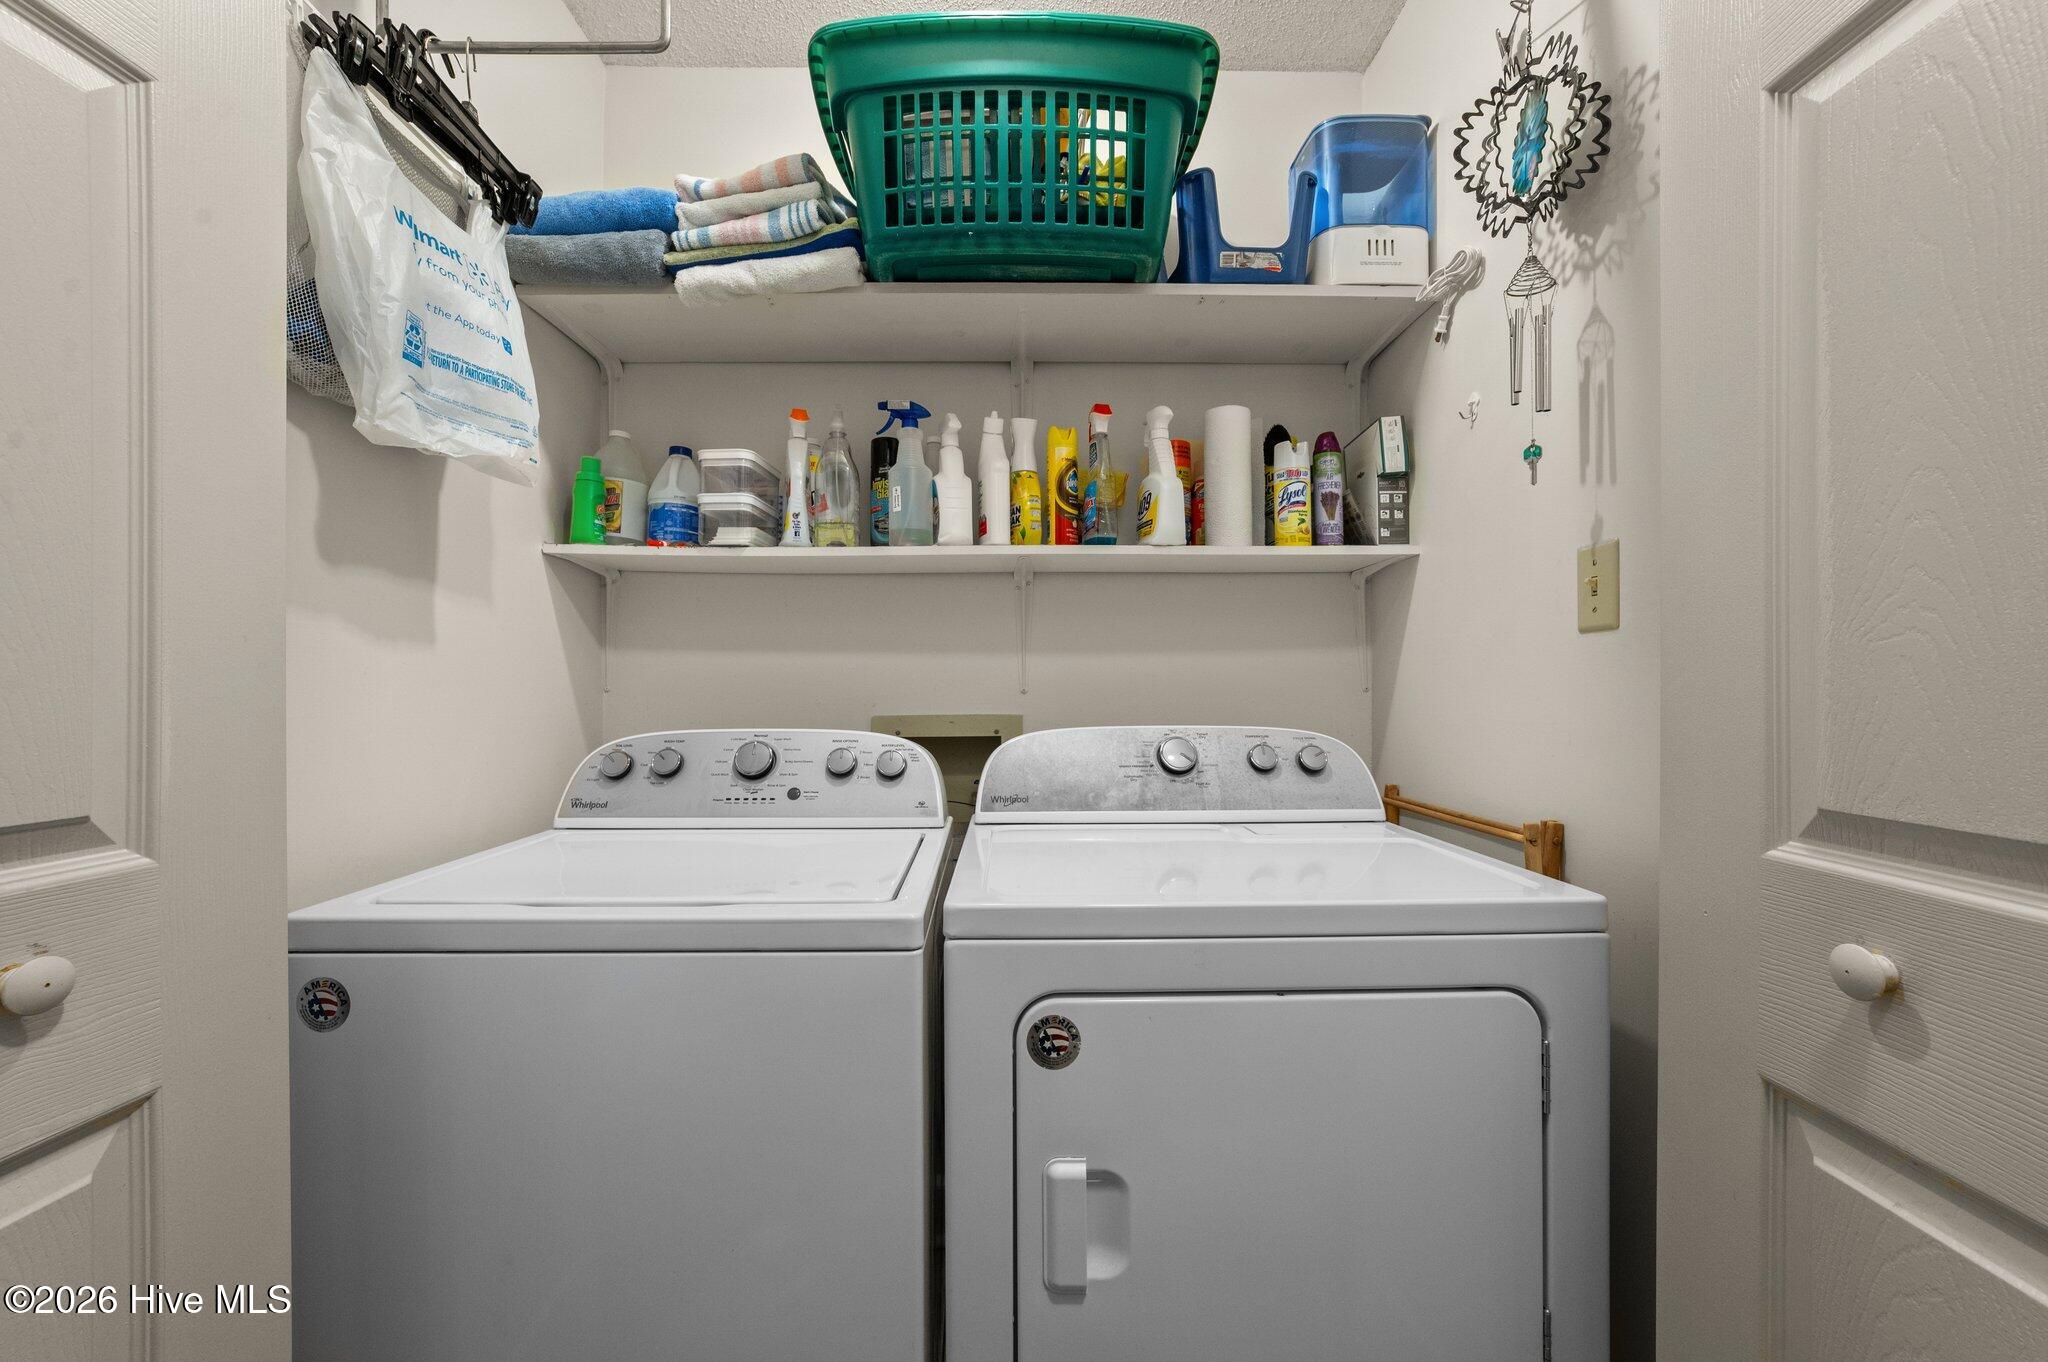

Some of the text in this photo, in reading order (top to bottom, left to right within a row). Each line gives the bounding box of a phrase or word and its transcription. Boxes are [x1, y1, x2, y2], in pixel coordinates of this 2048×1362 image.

[393, 205, 463, 266] Wlmart
[425, 257, 459, 284] from
[432, 305, 452, 320] the
[454, 314, 475, 331] App
[475, 325, 501, 344] today
[452, 361, 459, 373] TO
[460, 365, 464, 376] A
[1278, 485, 1306, 507] Lysol
[571, 800, 608, 810] Whirlpool
[991, 794, 1029, 807] Whirlpool
[303, 979, 348, 1007] AMERICA
[1033, 1016, 1079, 1041] AMERICA
